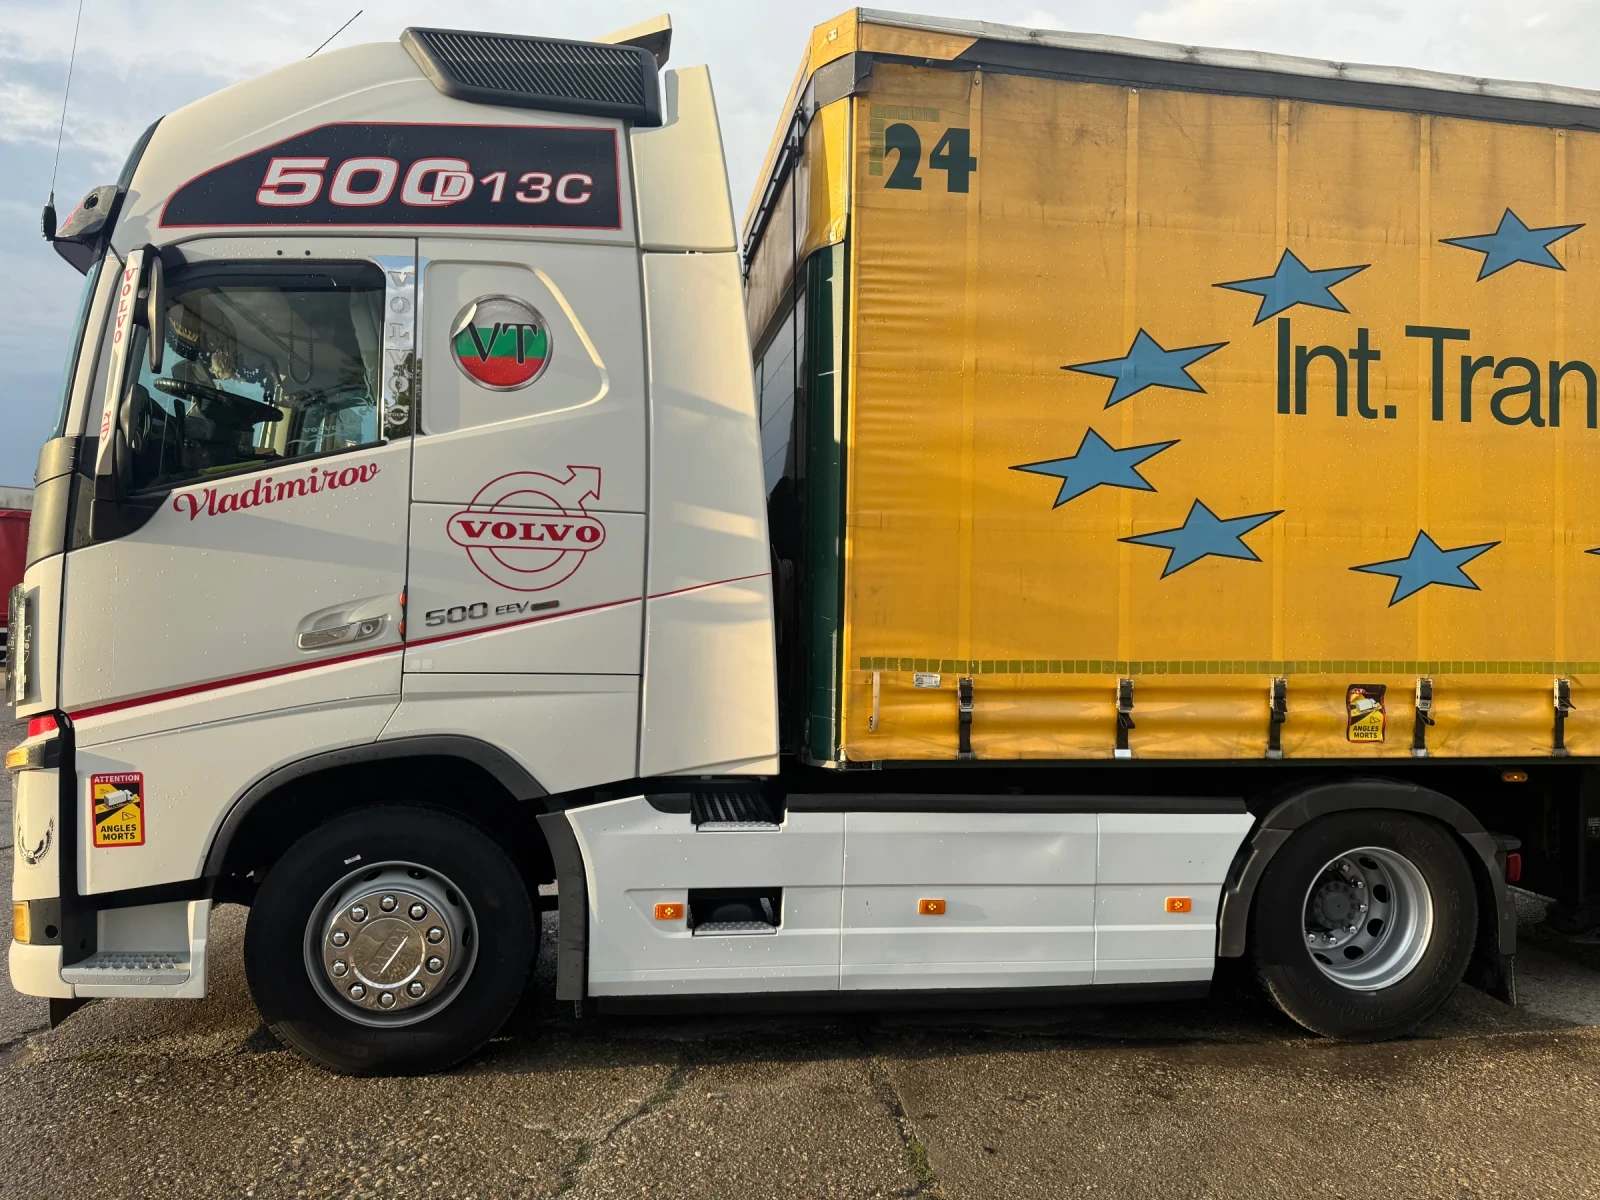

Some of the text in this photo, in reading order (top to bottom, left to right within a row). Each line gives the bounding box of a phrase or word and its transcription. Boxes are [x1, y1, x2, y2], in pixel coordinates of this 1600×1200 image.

[884, 122, 977, 193] 24
[255, 156, 470, 207] 500
[113, 267, 139, 344] VOLVO
[386, 270, 416, 393] VOLVO
[467, 321, 539, 365] VT
[1277, 317, 1598, 430] Int. Tran
[172, 462, 381, 522] Vladimirov
[456, 520, 601, 543] VOLVO
[425, 601, 489, 627] 500
[495, 601, 530, 616] EEV
[94, 774, 140, 783] ATTENTION
[100, 823, 137, 833] ANGLES
[102, 832, 136, 841] MORTS
